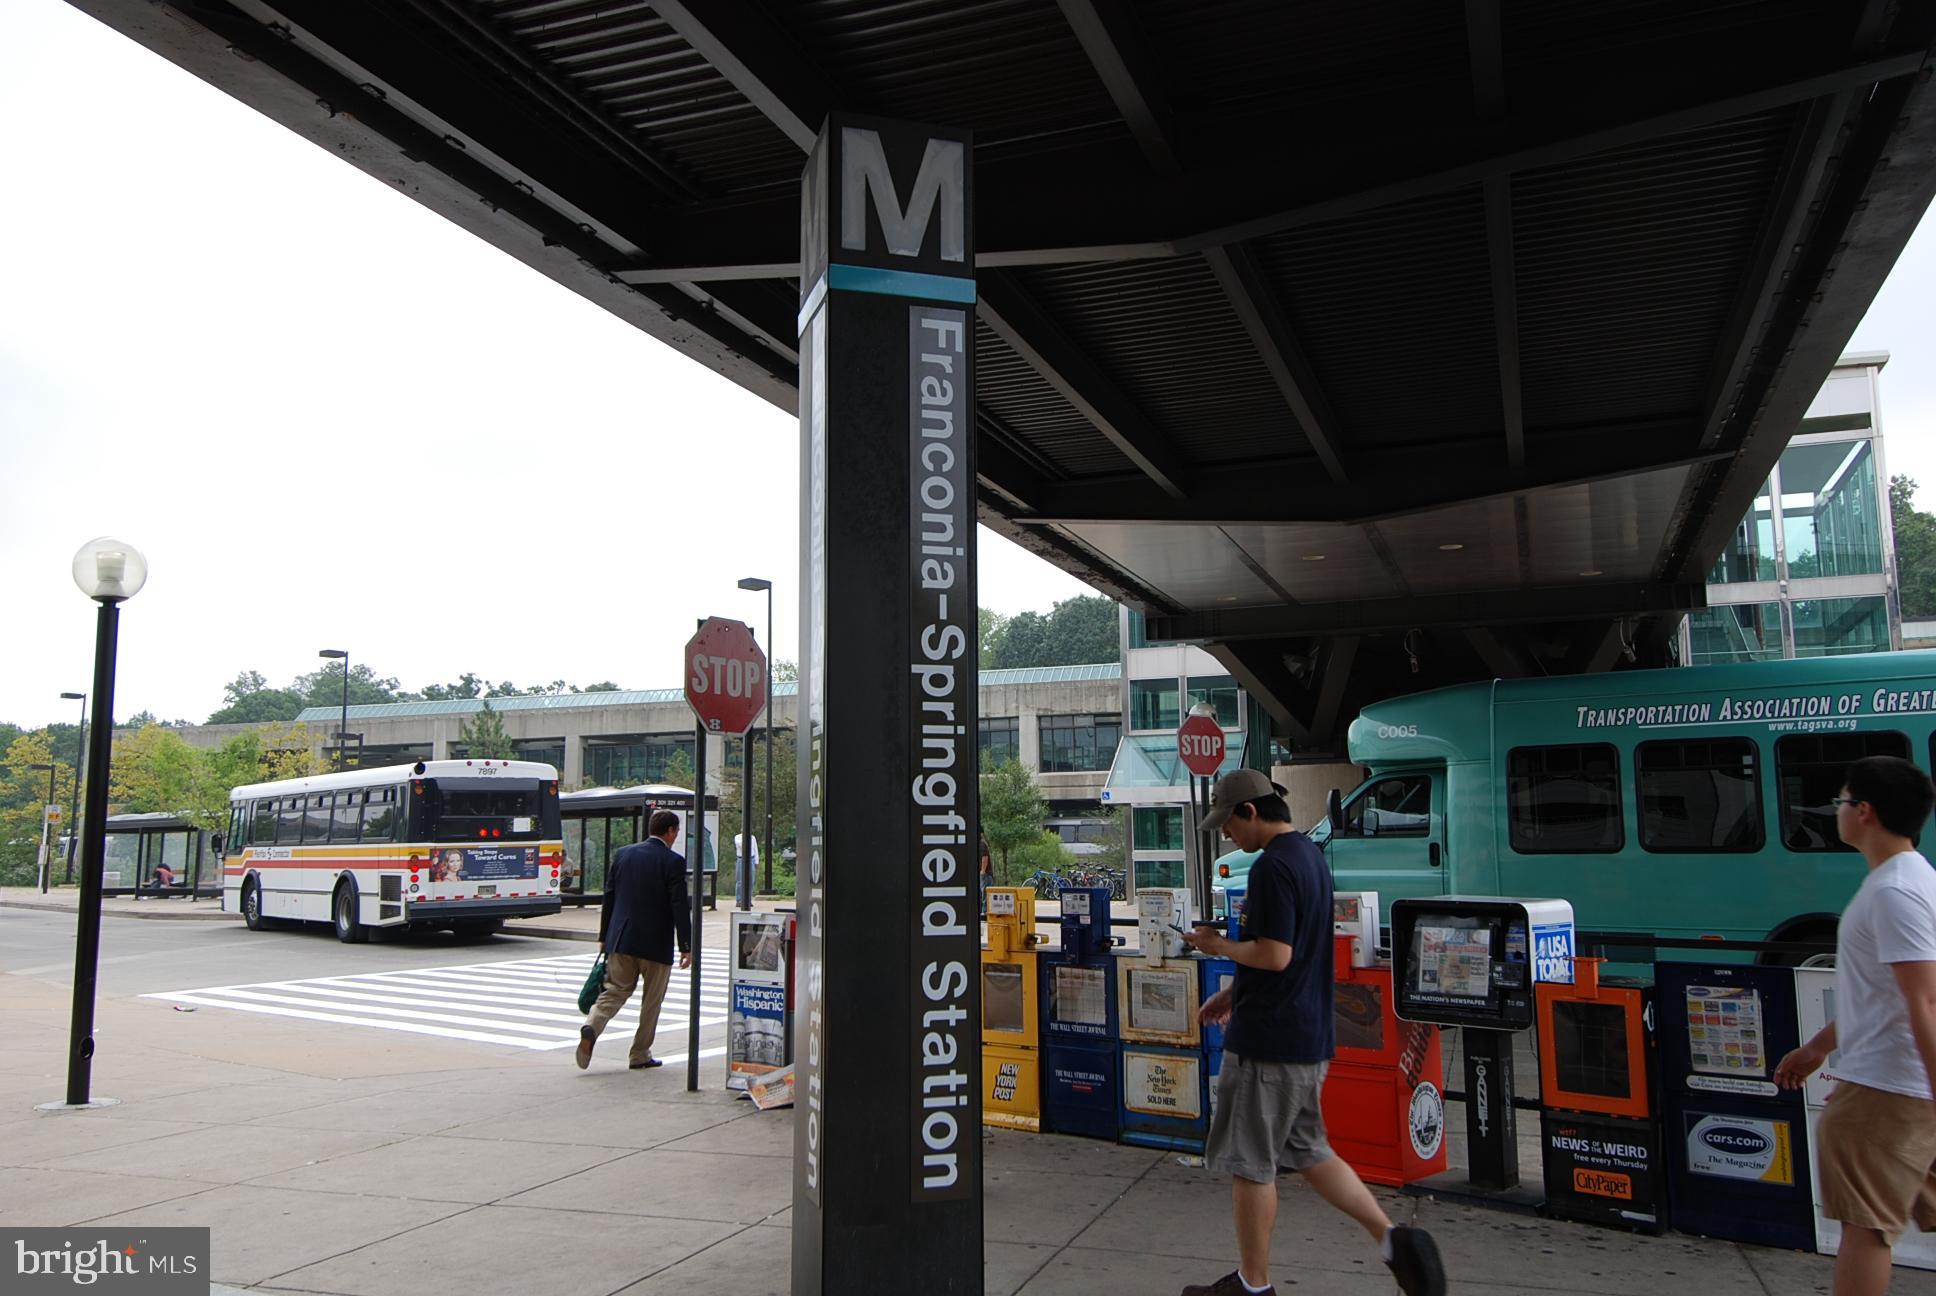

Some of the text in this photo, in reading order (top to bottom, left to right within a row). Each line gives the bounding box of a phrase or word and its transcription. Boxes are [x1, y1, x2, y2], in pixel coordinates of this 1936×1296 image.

[841, 126, 965, 263] M
[691, 653, 760, 698] STOP
[1768, 719, 1857, 732] www.tagsva.org
[1181, 734, 1222, 757] STOP
[911, 318, 968, 1189] Franconia-Springfield Station
[478, 767, 498, 777] 7897
[1547, 935, 1569, 958] USA
[1537, 957, 1571, 981] TODAY
[735, 986, 784, 1001] Washington
[736, 995, 784, 1012] Hispanic
[1450, 997, 1487, 1007] NEWSPAPER
[807, 960, 822, 1190] Station
[1000, 1063, 1020, 1076] NEW
[996, 1074, 1017, 1088] YORK
[1147, 1073, 1161, 1083] New
[993, 1086, 1015, 1101] POST
[1147, 1095, 1177, 1106] SOLD HERE
[1551, 1135, 1589, 1152] NEWS
[1602, 1142, 1648, 1159] WEIRD
[1705, 1133, 1764, 1148] cars.com
[1574, 1153, 1648, 1171] free every Thursday
[1708, 1155, 1767, 1170] The Magazine
